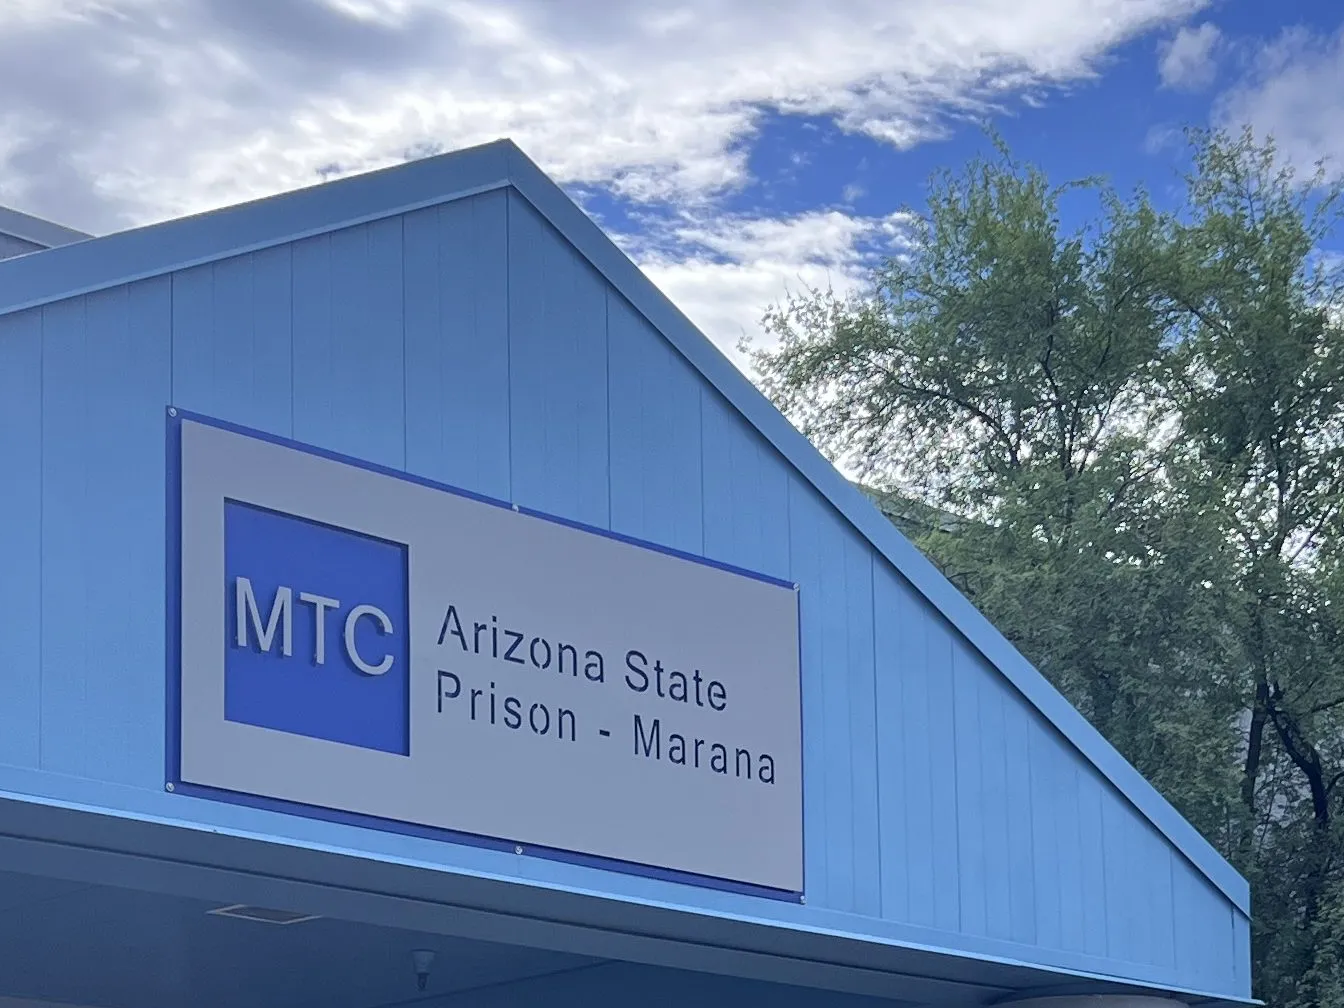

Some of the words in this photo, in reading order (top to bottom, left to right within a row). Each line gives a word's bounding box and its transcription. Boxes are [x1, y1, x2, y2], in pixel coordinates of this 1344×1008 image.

[235, 576, 394, 677] MTC
[437, 605, 605, 683] Arizona
[624, 650, 728, 713] State
[437, 671, 578, 742] Prison
[633, 714, 775, 785] Marana
